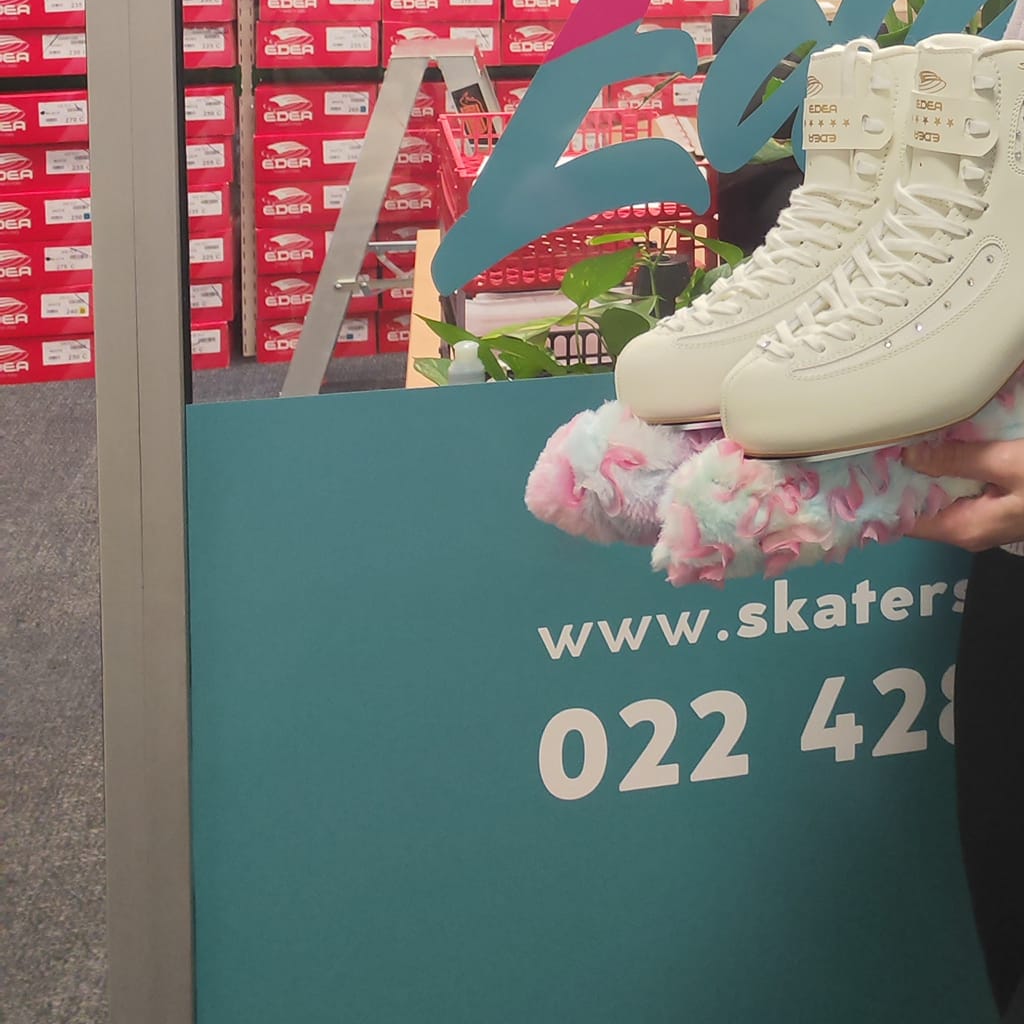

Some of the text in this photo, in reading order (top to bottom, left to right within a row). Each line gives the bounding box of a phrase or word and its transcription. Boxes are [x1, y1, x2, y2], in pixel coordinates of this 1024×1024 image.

[265, 43, 314, 56] EDEA
[809, 104, 838, 114] EDEA
[916, 99, 943, 112] EDEA
[264, 111, 313, 123] EDEA
[263, 158, 311, 170] EDEA
[397, 153, 432, 163] DEA
[264, 205, 312, 216] EDEA
[385, 199, 432, 210] EDEA
[265, 250, 313, 262] EDEA
[391, 288, 412, 298] ED
[387, 331, 409, 342] ED
[265, 339, 299, 351] EDE
[538, 689, 750, 801] 022
